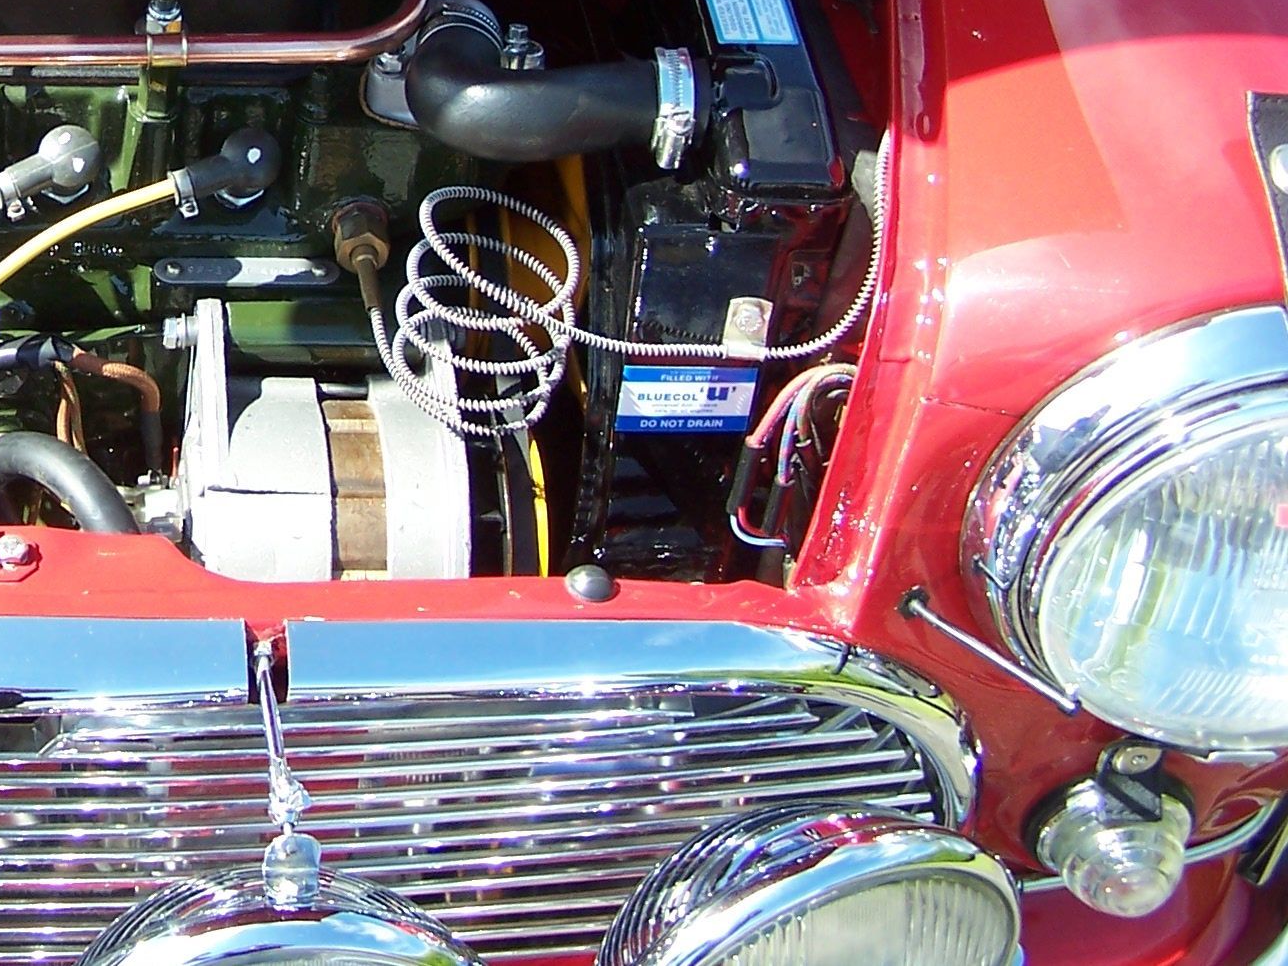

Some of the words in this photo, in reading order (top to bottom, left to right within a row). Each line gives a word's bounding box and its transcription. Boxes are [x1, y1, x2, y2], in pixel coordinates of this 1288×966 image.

[660, 374, 693, 382] FILLED
[637, 393, 699, 401] BLUECOL
[639, 419, 658, 428] DO
[659, 419, 684, 428] NOT
[686, 419, 723, 428] DRAIN
